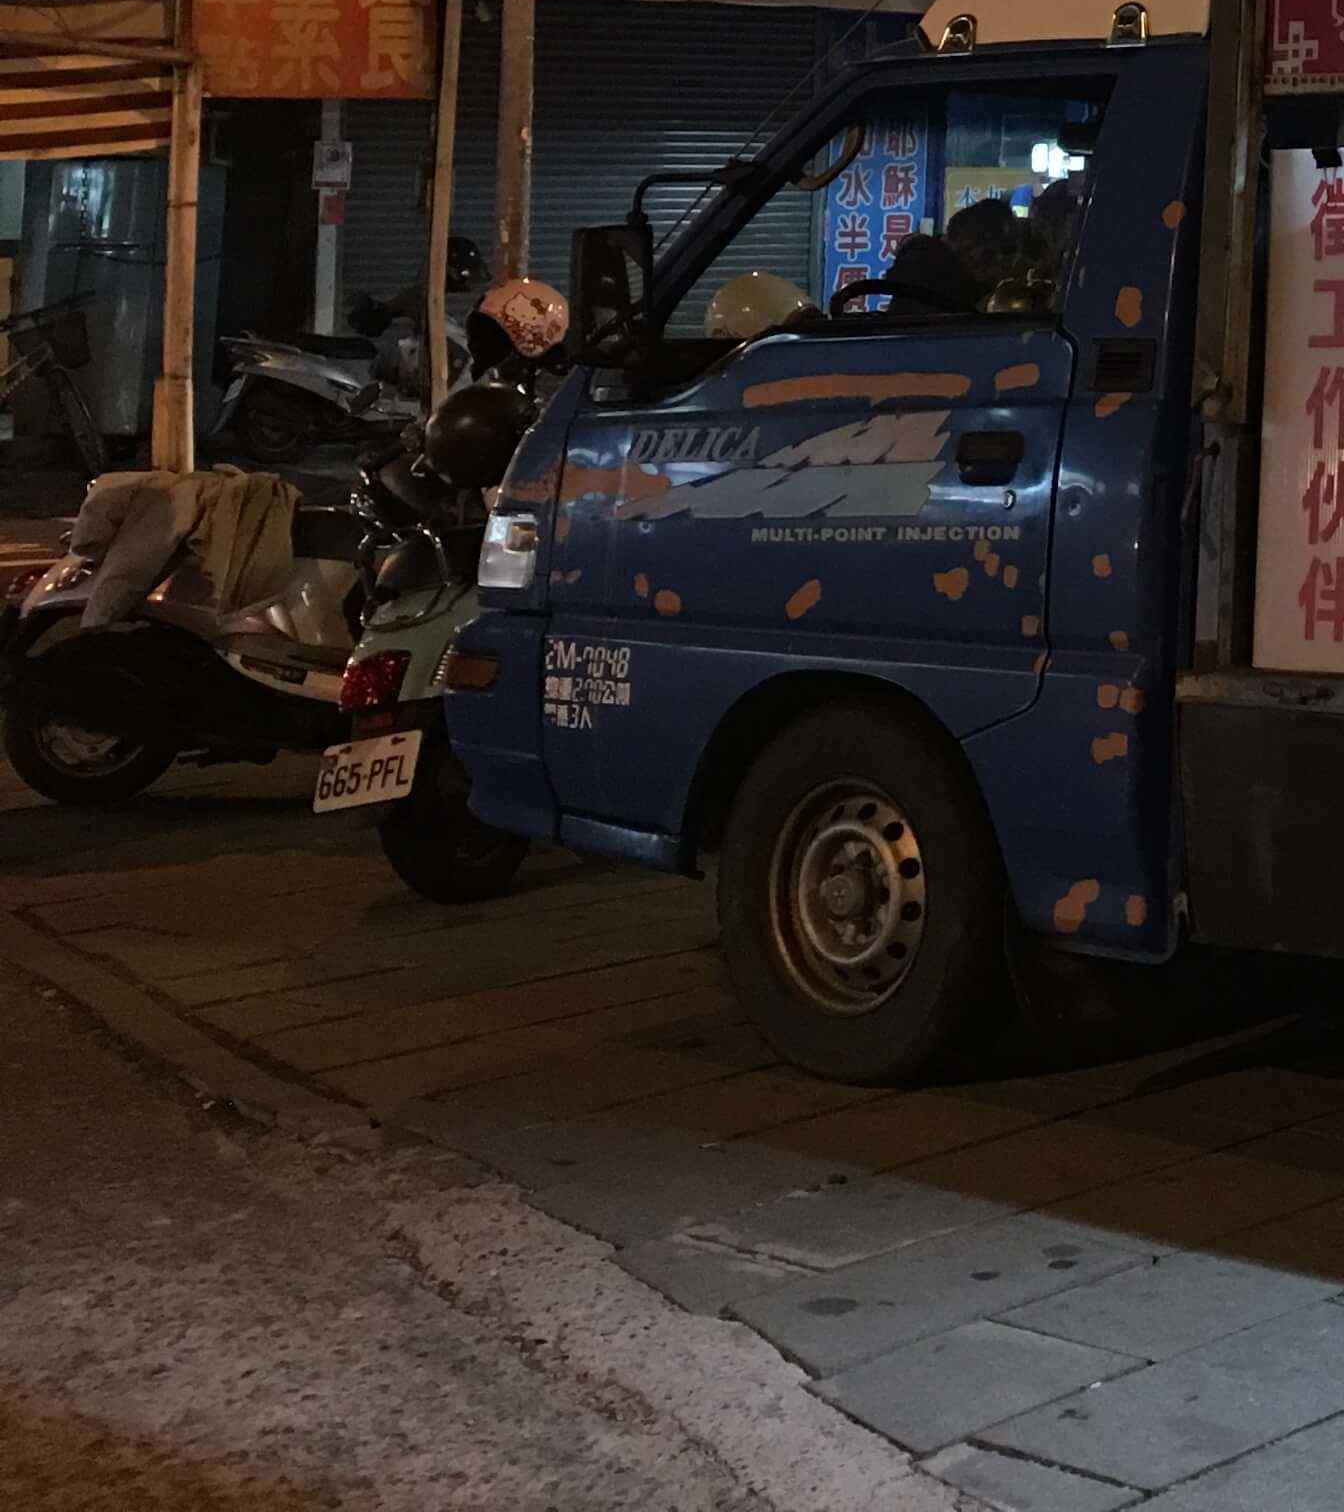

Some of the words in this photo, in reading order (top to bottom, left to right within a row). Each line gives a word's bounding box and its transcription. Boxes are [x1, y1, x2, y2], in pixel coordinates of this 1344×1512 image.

[631, 425, 761, 461] DELICA
[750, 526, 887, 543] MULTI-POINT
[897, 525, 1021, 542] INJECTION
